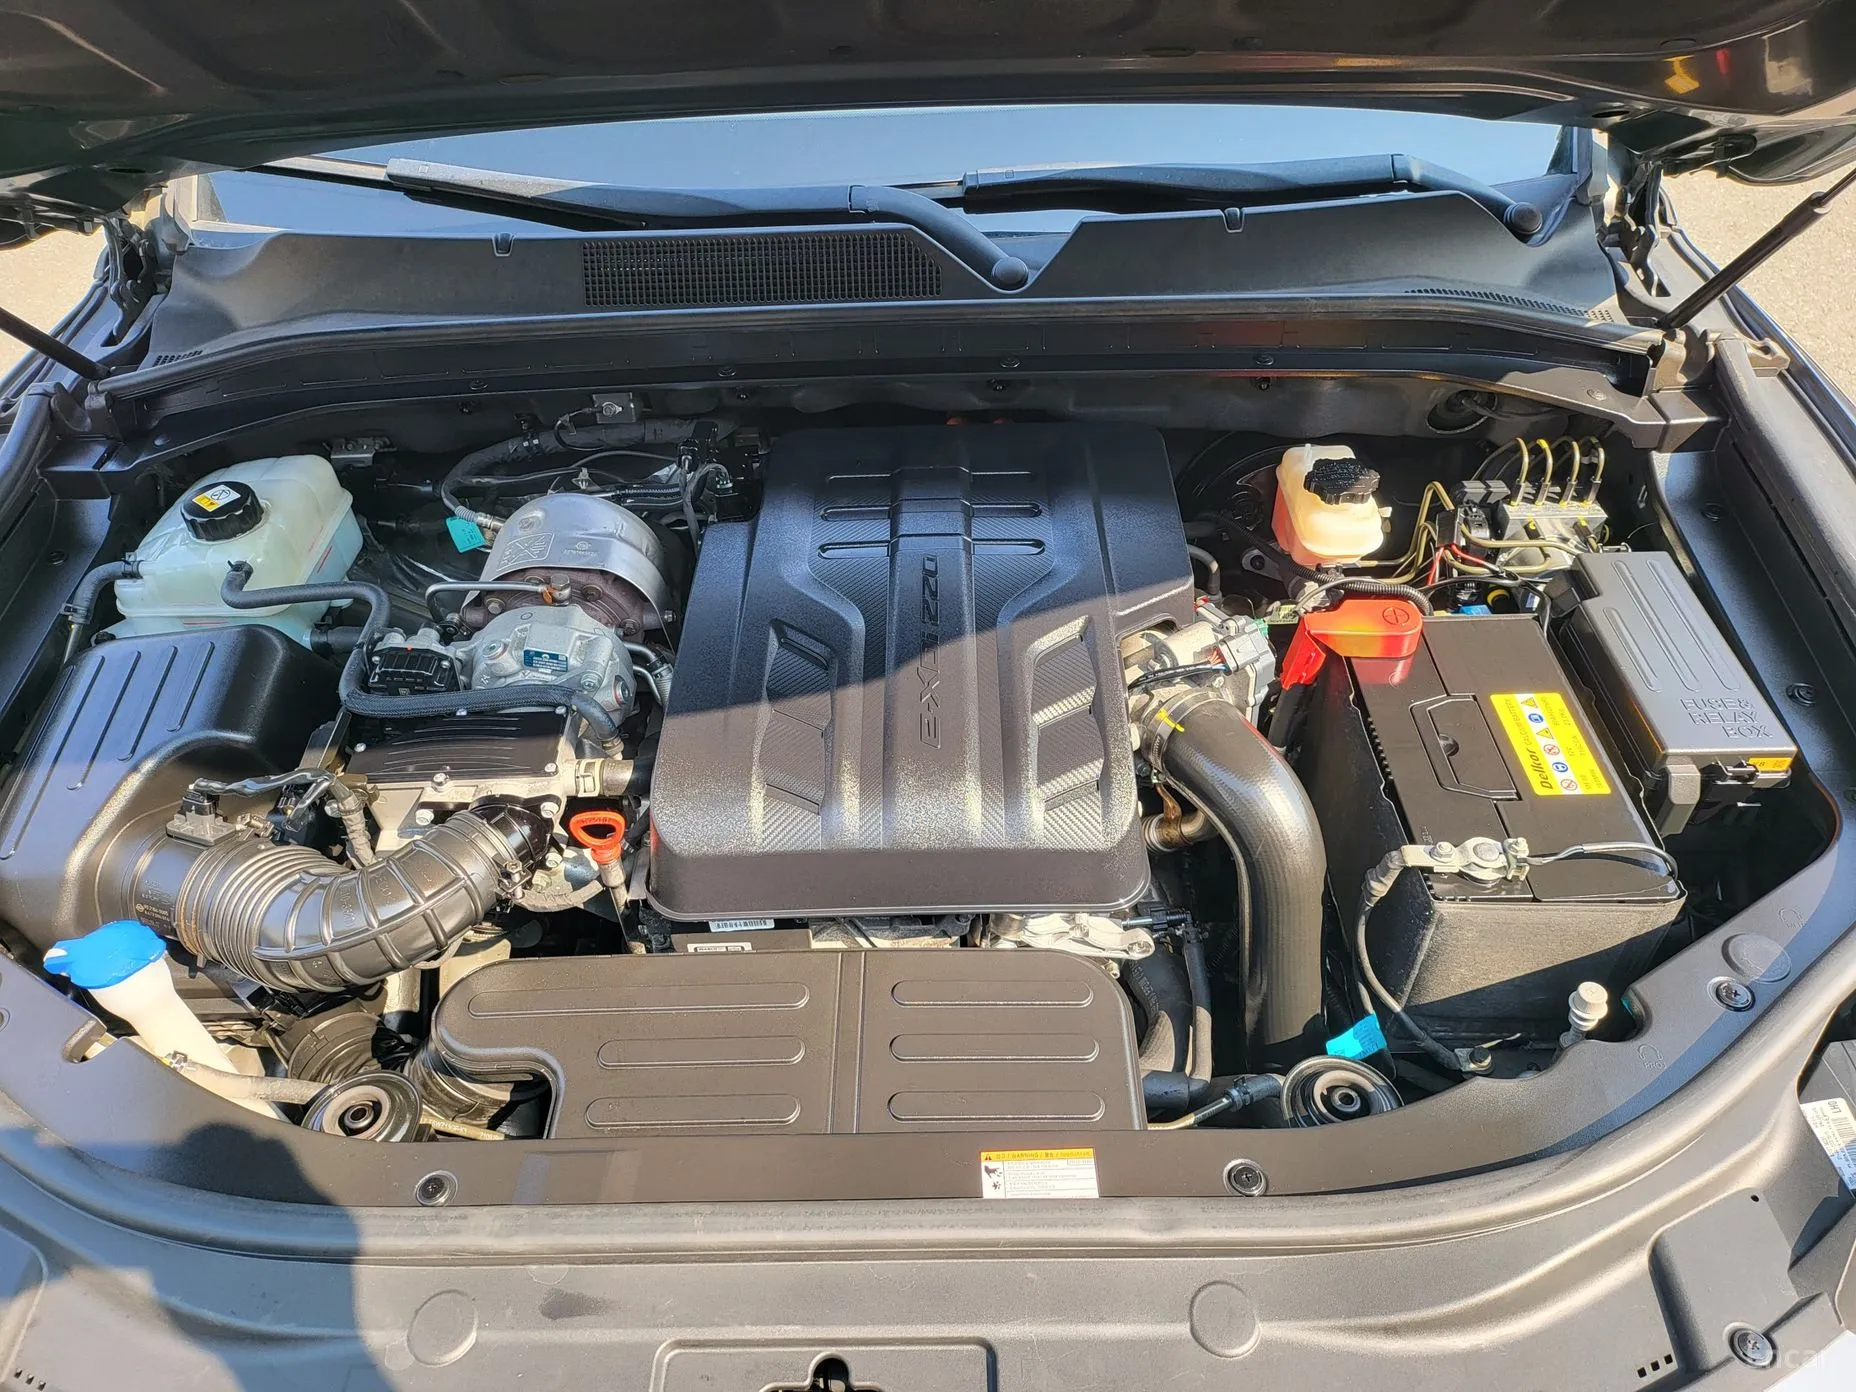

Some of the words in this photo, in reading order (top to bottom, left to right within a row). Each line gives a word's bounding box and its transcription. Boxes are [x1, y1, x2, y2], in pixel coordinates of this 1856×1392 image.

[921, 554, 940, 626] 220
[1688, 711, 1759, 725] RELAY
[1722, 725, 1774, 738] BOX
[1526, 748, 1554, 790] Delkor
